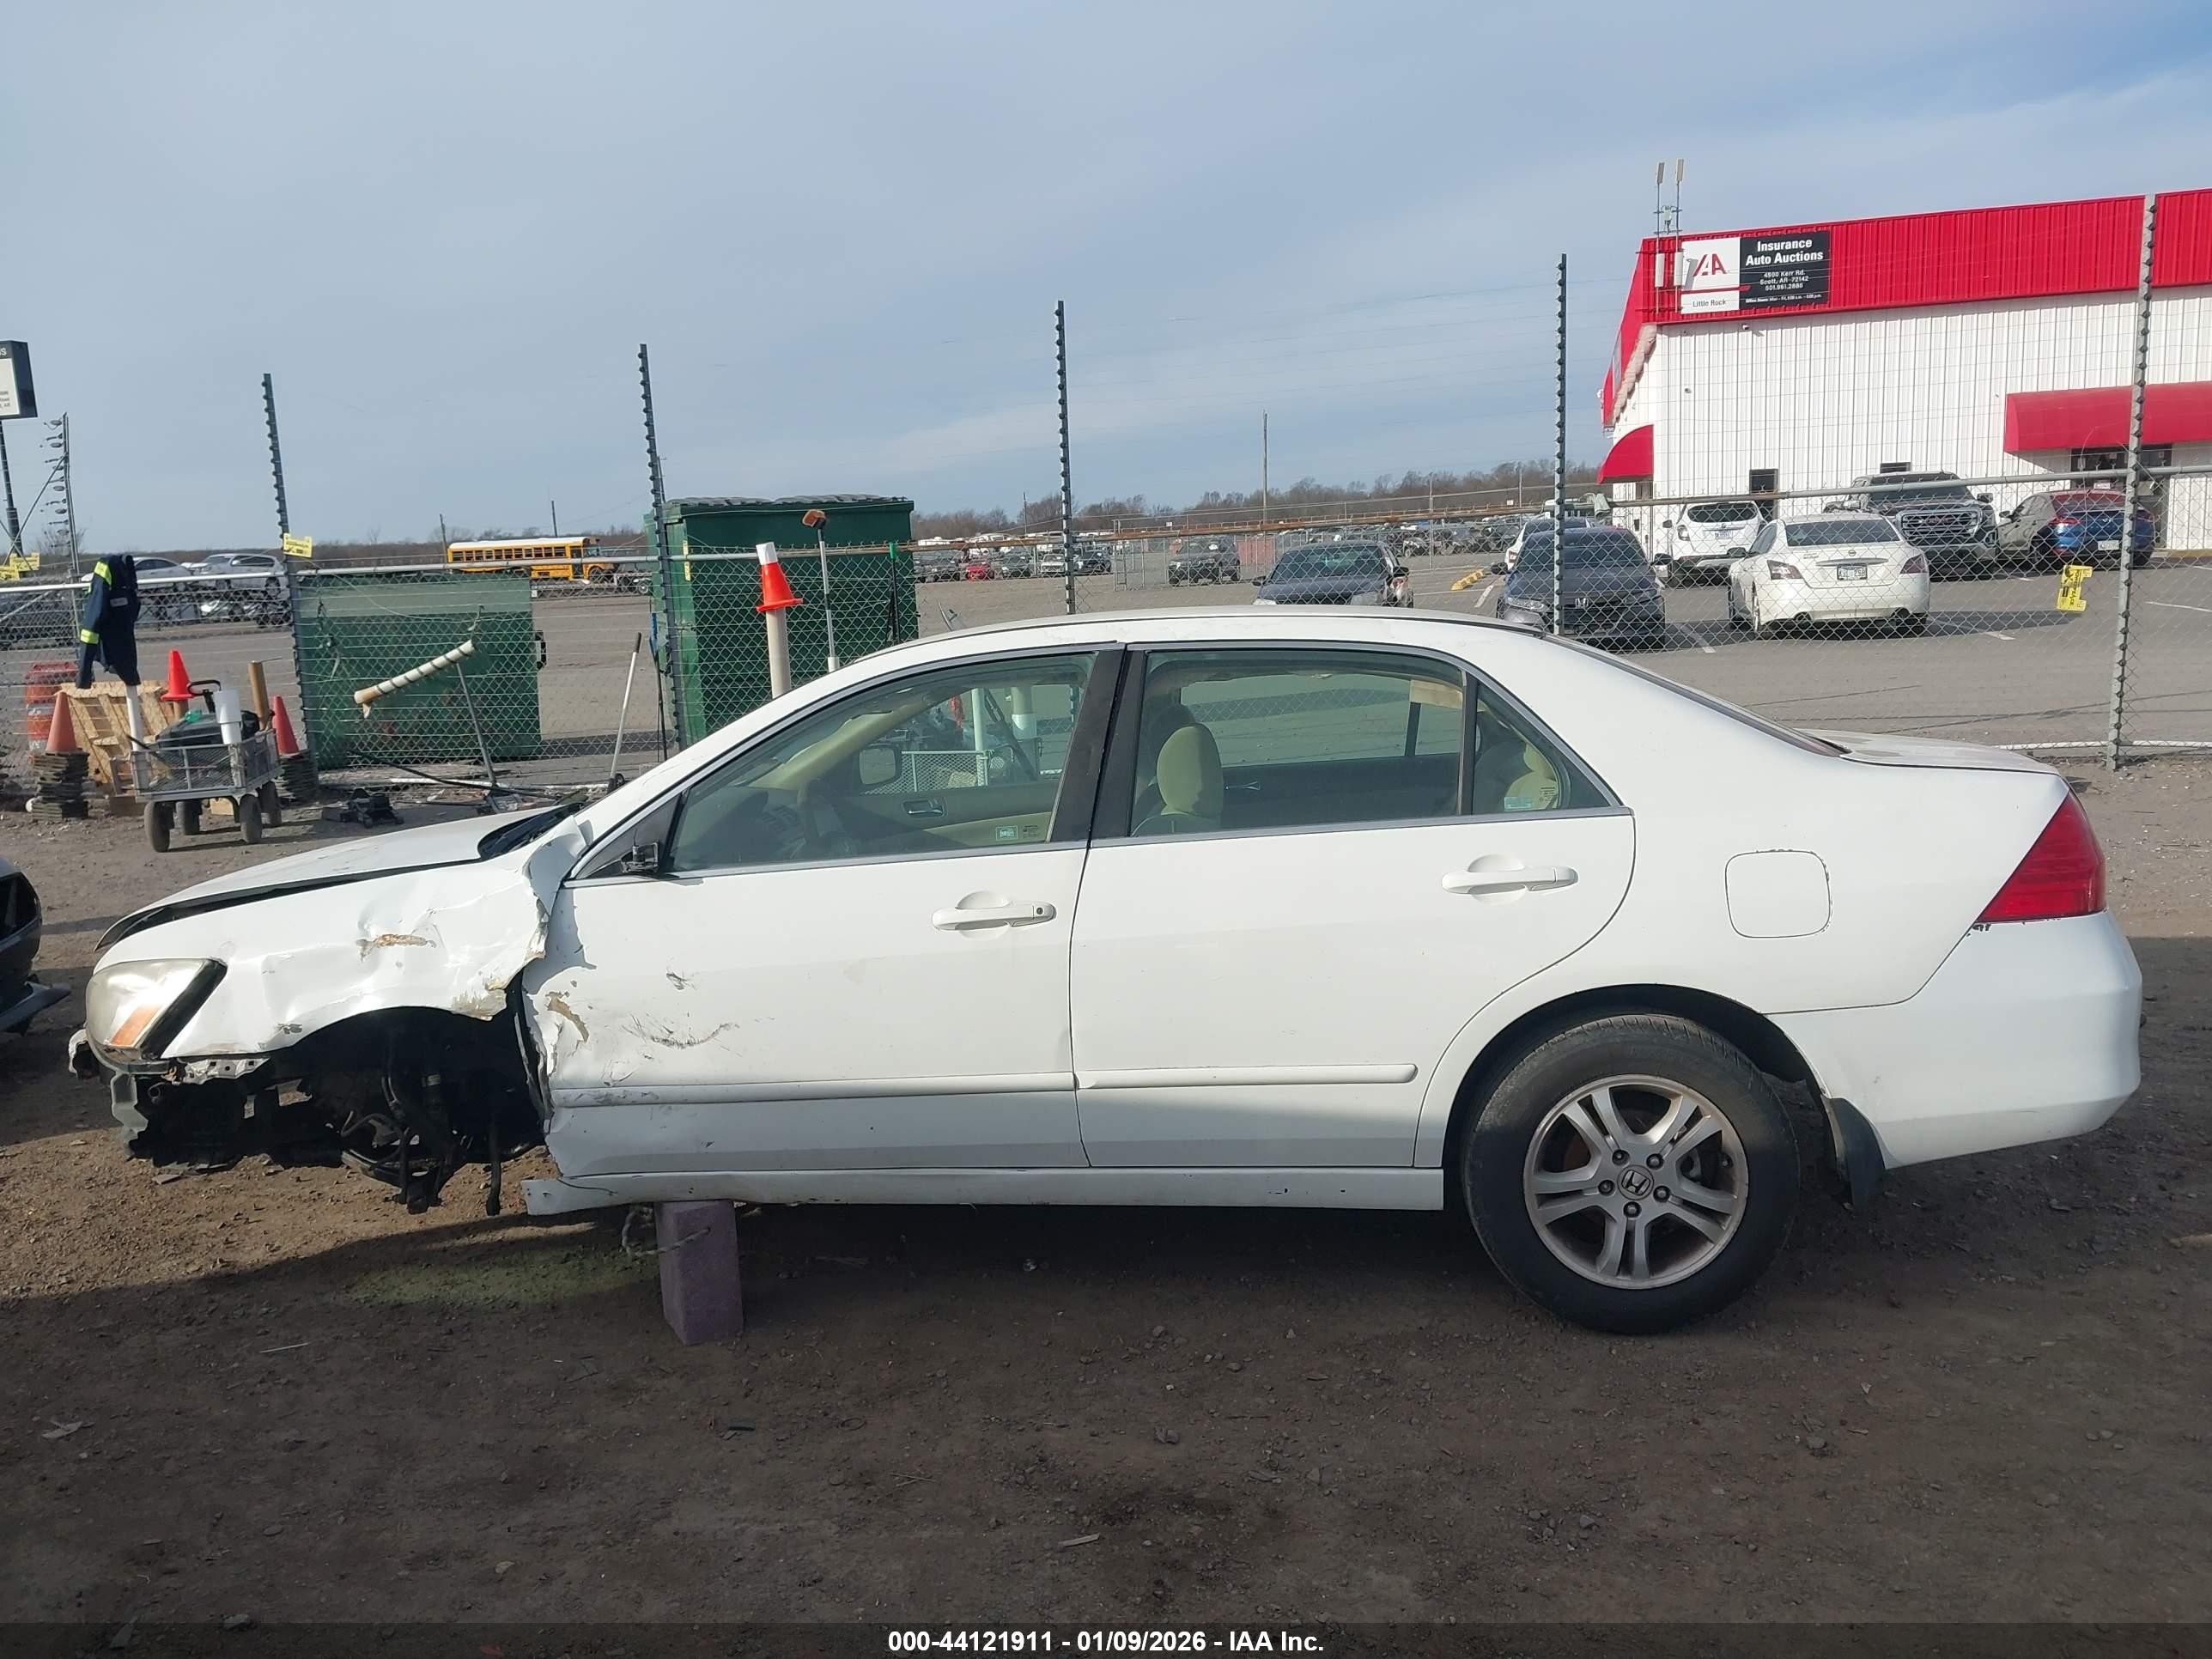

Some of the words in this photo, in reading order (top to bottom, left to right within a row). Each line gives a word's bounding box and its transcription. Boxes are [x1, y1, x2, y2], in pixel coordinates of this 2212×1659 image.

[1757, 240, 1813, 252] Insurance
[1745, 255, 1771, 266] Auto
[1773, 251, 1824, 264] Auctions
